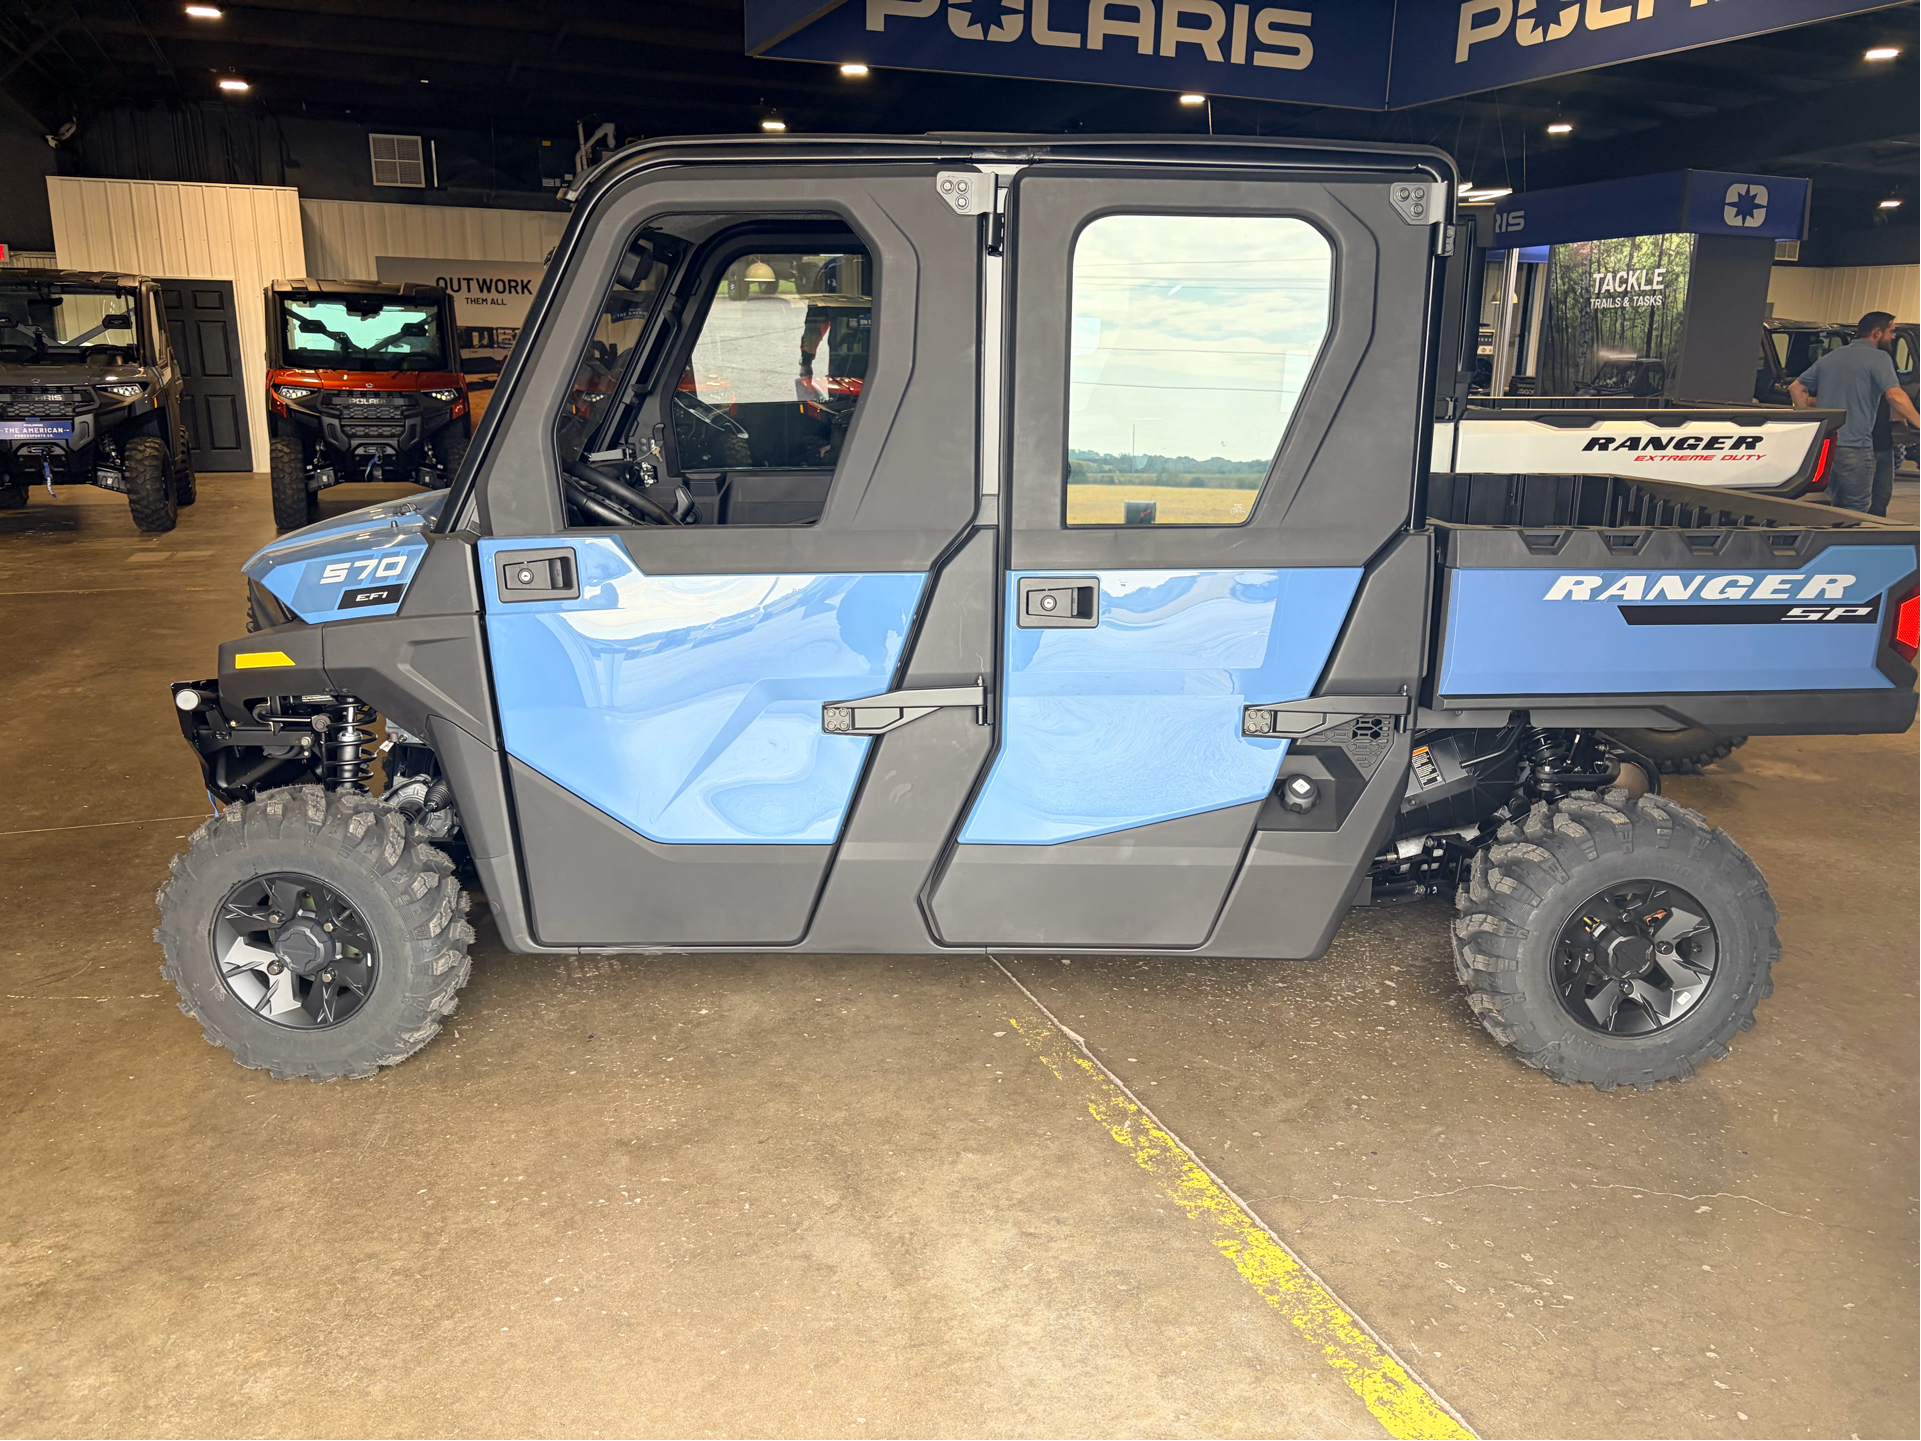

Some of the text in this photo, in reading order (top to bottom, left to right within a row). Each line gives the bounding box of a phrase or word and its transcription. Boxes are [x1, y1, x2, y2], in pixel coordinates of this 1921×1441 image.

[866, 0, 1314, 71] POLARIS
[436, 276, 533, 296] OUTWORK
[1592, 268, 1667, 294] TACKLE
[465, 297, 507, 306] THEM ALL
[1590, 295, 1663, 310] TRAILS & TASKS
[1581, 436, 1764, 452] RANGER
[1633, 454, 1716, 462] EXTREME
[319, 555, 408, 585] 570
[1543, 574, 1857, 601] RANGER
[355, 591, 388, 602] EFI
[1780, 607, 1874, 621] SP
